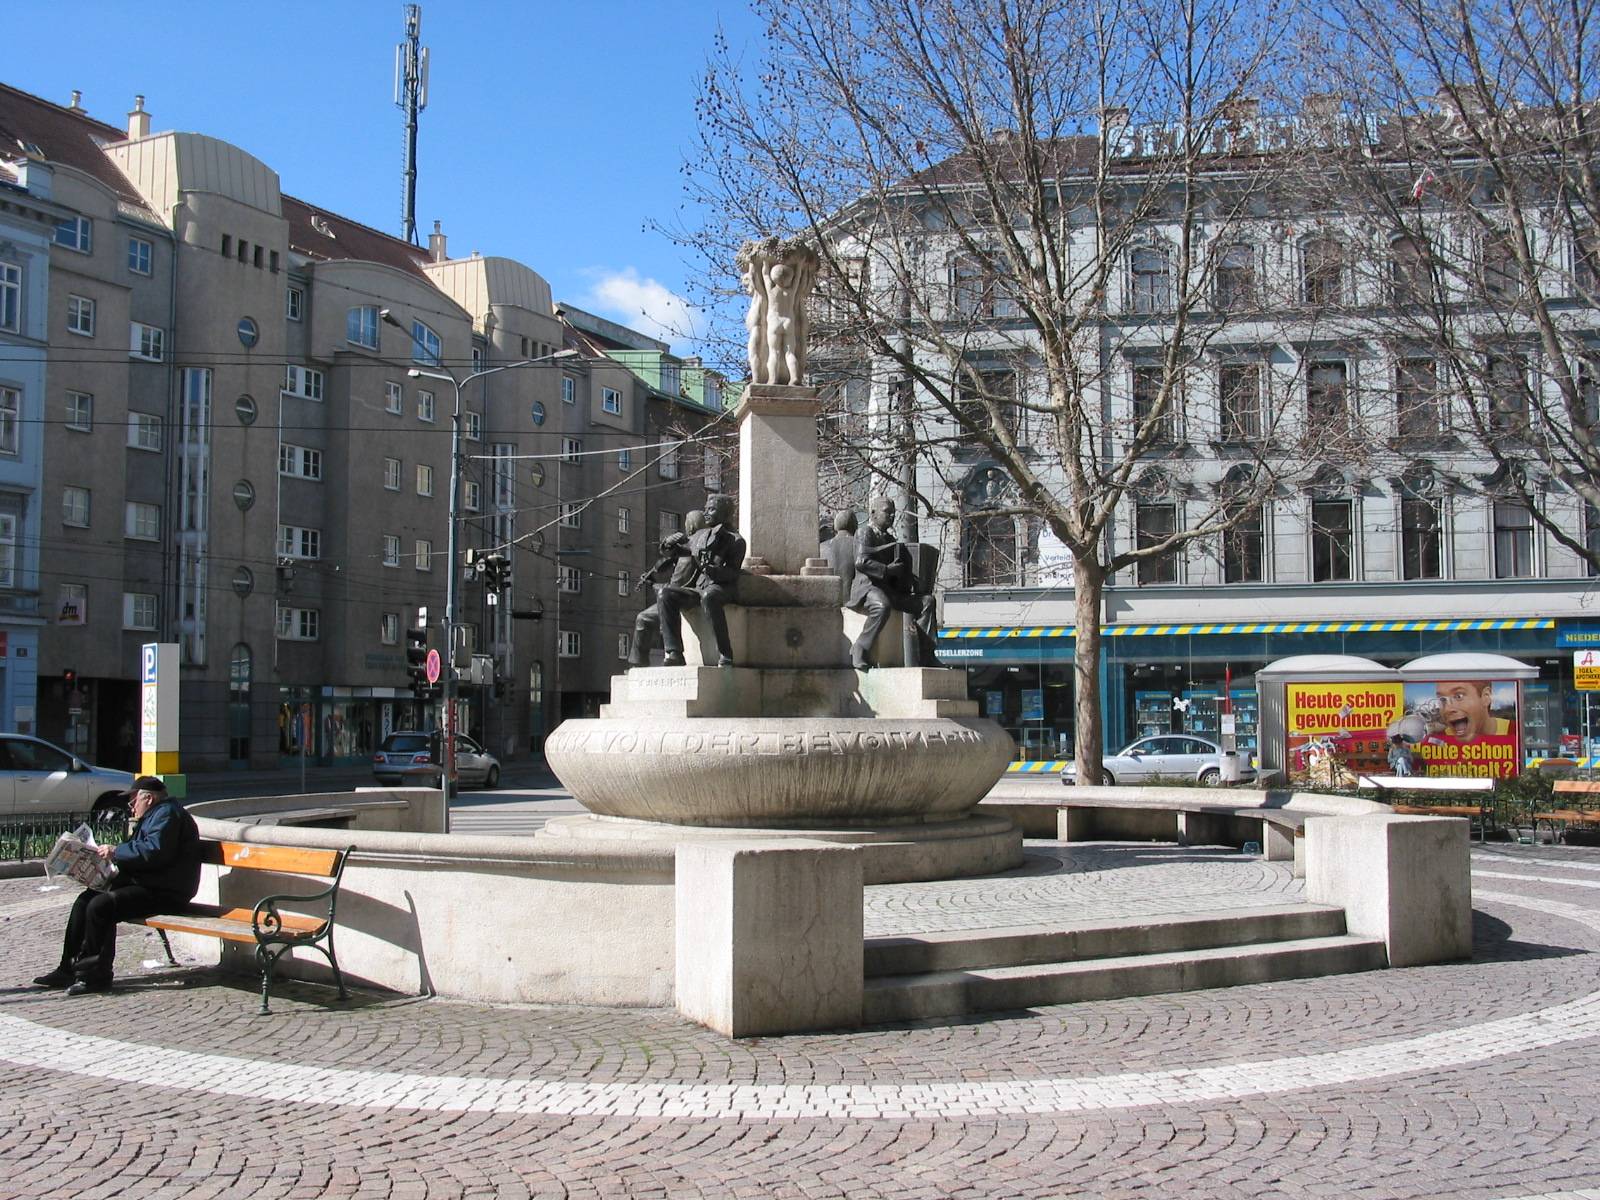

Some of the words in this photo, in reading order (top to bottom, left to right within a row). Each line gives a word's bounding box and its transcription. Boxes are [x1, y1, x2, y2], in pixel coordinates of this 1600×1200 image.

[62, 601, 77, 615] dm
[145, 648, 155, 680] P
[1295, 691, 1342, 708] Heute
[1347, 691, 1396, 708] schon
[1462, 742, 1513, 759] schon
